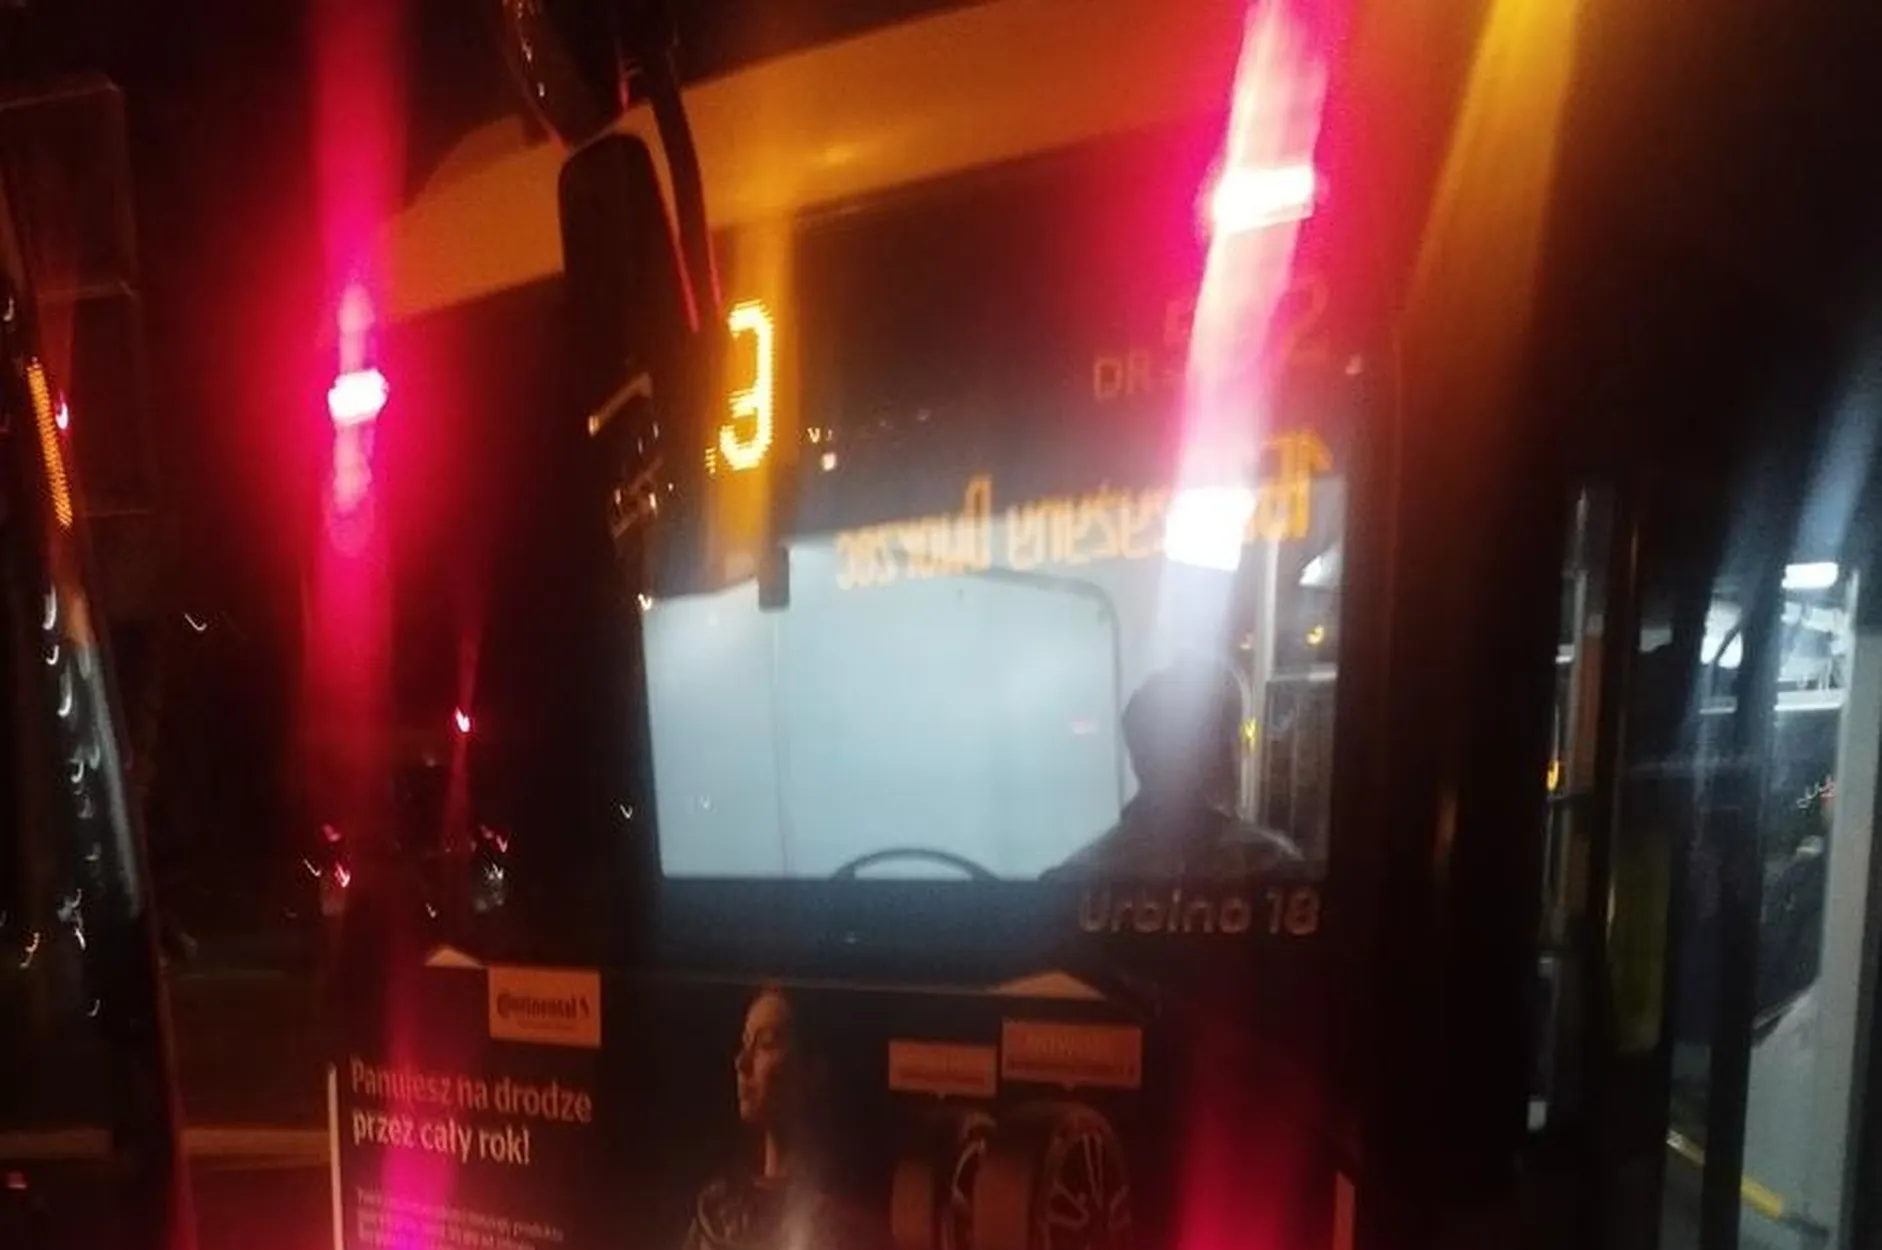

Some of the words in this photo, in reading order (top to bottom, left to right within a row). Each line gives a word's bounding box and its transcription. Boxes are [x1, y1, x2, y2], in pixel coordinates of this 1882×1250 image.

[1077, 886, 1253, 935] Urbino
[1264, 884, 1323, 937] 18
[350, 1056, 451, 1108] Panujesz
[457, 1072, 489, 1111] na
[494, 1075, 594, 1125] drodze
[352, 1108, 415, 1149] przez
[478, 1123, 532, 1166] rok!
